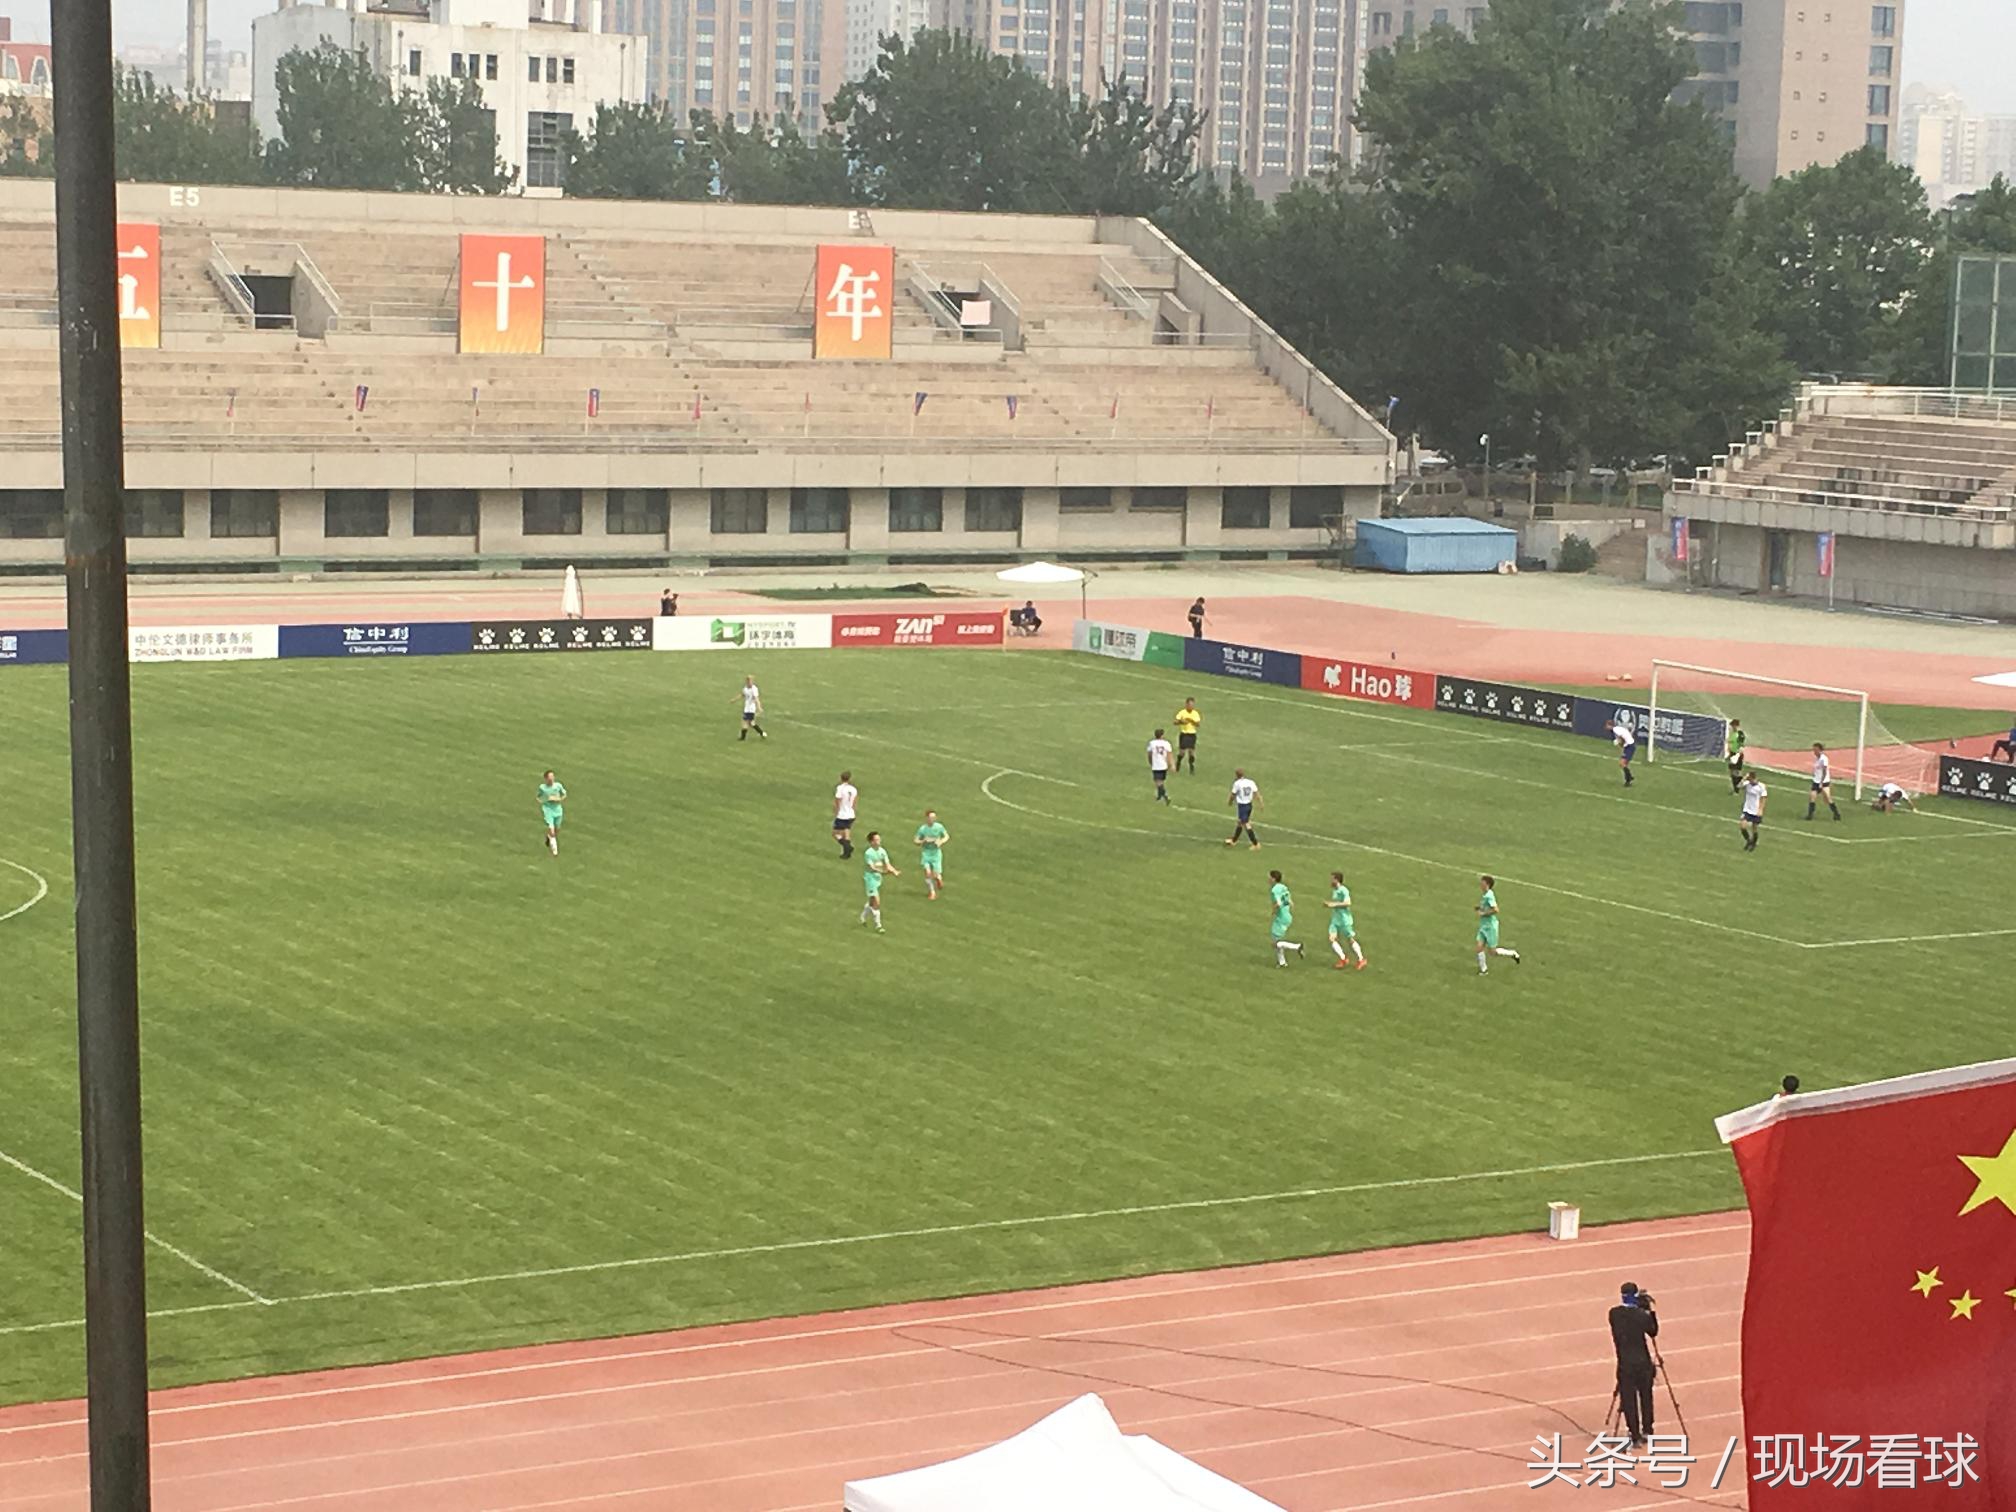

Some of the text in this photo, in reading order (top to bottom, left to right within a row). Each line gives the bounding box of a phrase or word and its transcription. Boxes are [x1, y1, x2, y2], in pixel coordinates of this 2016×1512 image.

[169, 186, 200, 207] E5
[472, 251, 535, 332] 十
[825, 263, 883, 342] 年
